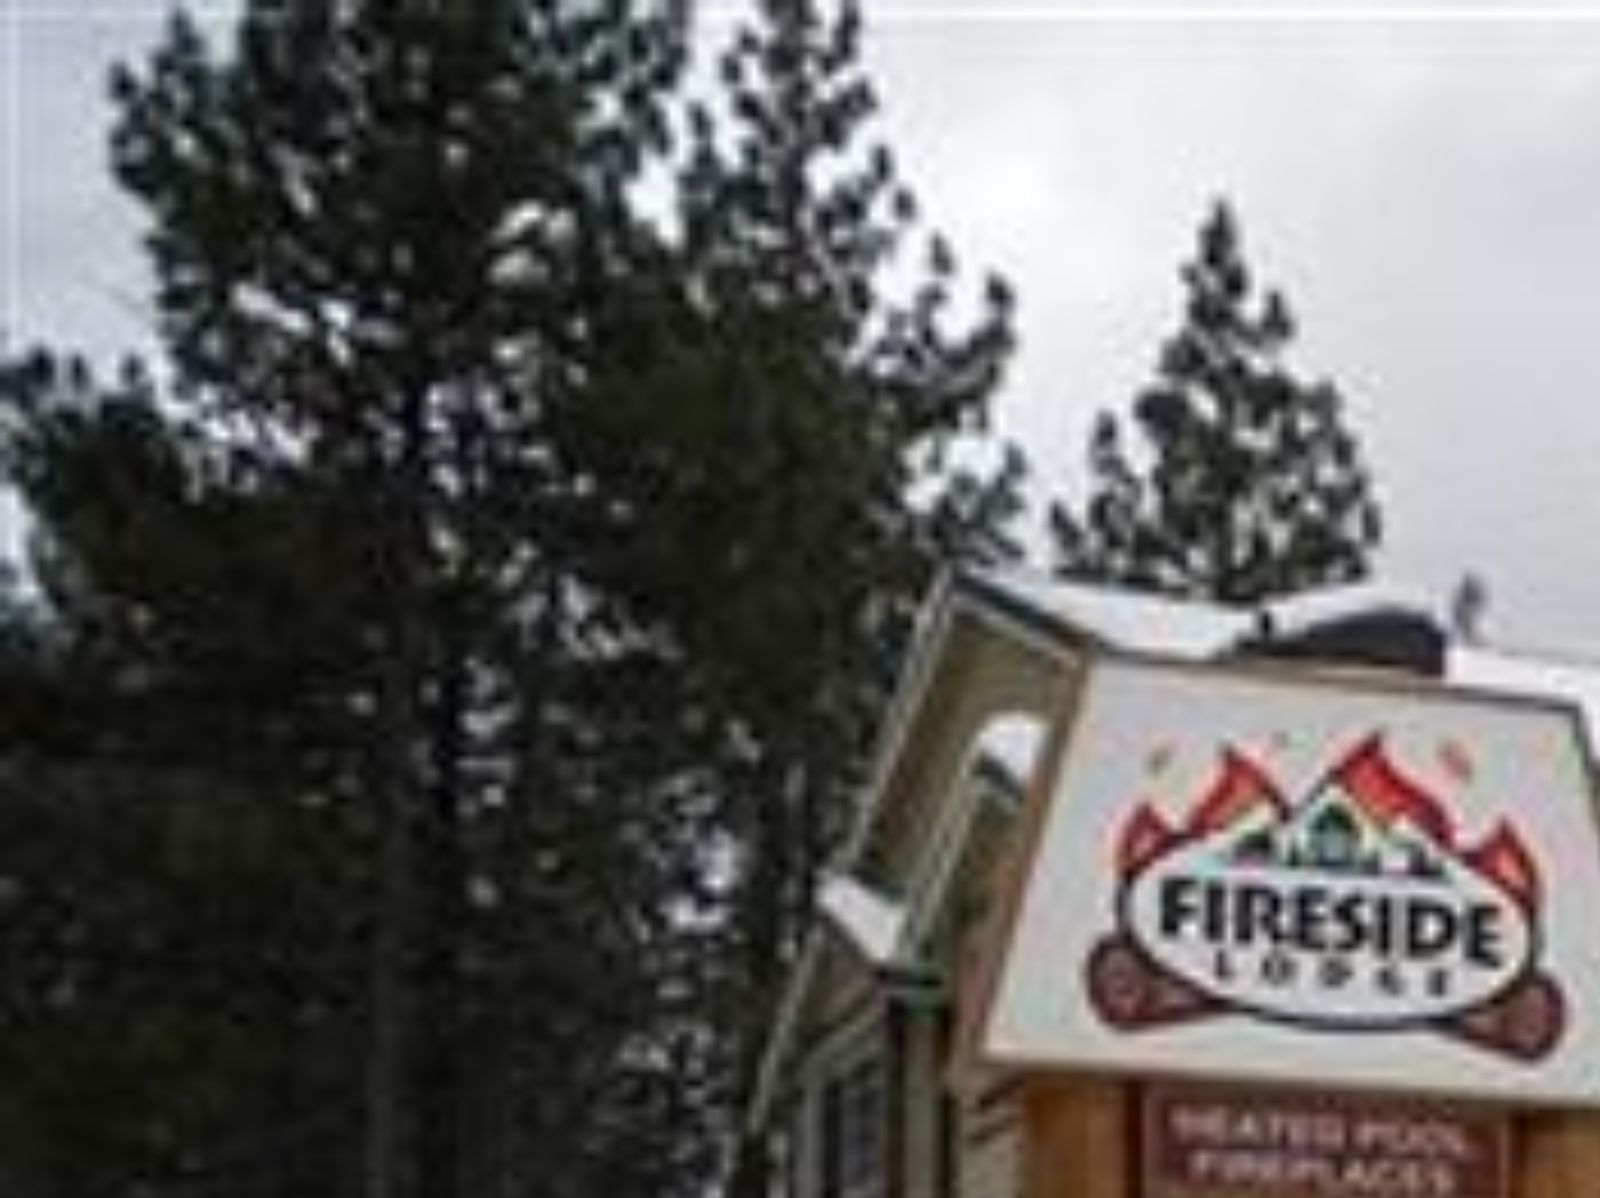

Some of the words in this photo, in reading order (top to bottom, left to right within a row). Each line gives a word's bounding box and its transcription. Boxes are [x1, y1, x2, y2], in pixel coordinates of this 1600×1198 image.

[1159, 877, 1503, 967] FIRESIDE
[1212, 946, 1452, 997] LODGE
[1170, 1104, 1347, 1147] HEATED
[1356, 1117, 1469, 1157] POOL
[1186, 1149, 1456, 1197] FIREPLACES
